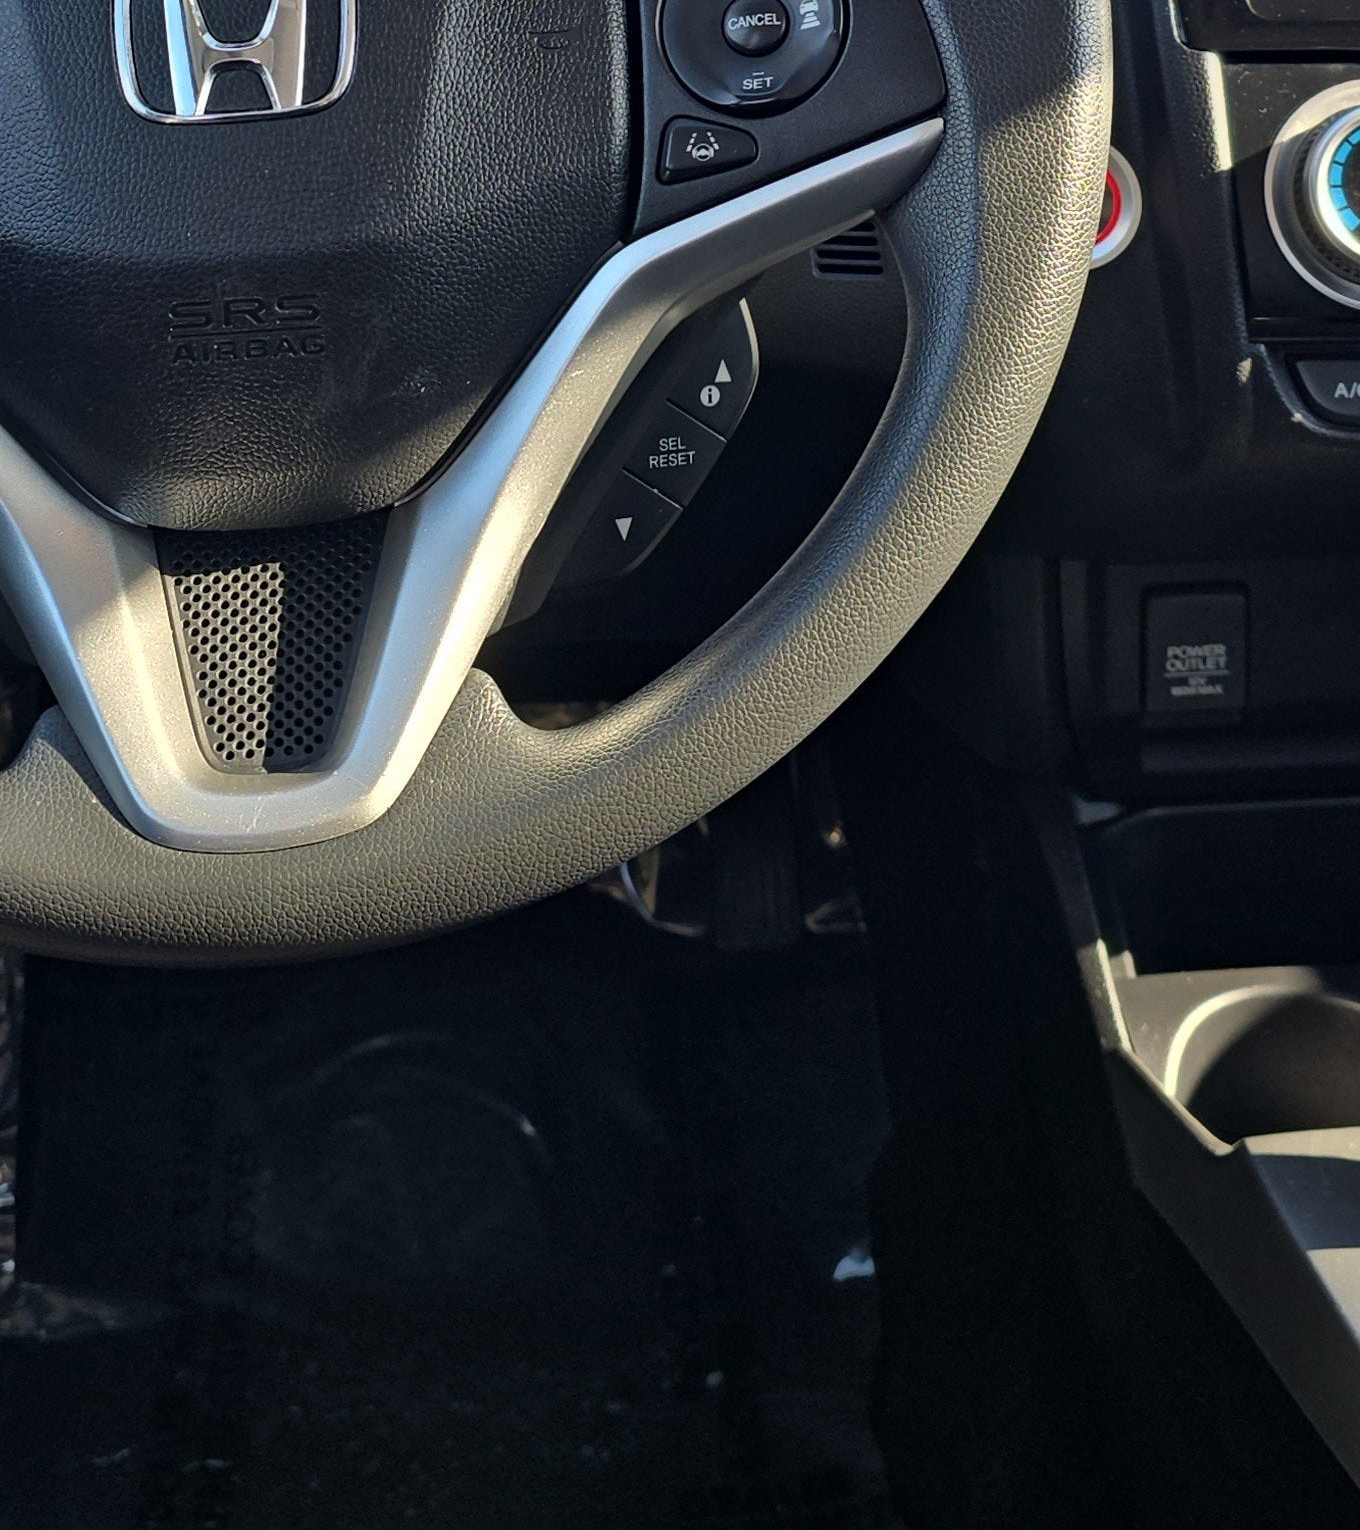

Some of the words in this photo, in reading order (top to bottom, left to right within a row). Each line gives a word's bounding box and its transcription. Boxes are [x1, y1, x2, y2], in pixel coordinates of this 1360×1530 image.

[728, 13, 781, 30] CANCEL
[742, 76, 773, 90] SET
[168, 294, 323, 326] SRS
[170, 337, 327, 365] AIRBAG
[659, 437, 686, 452] SEL
[649, 451, 696, 469] RESET
[1167, 643, 1226, 658] POWER
[1165, 657, 1227, 672] OUTLET
